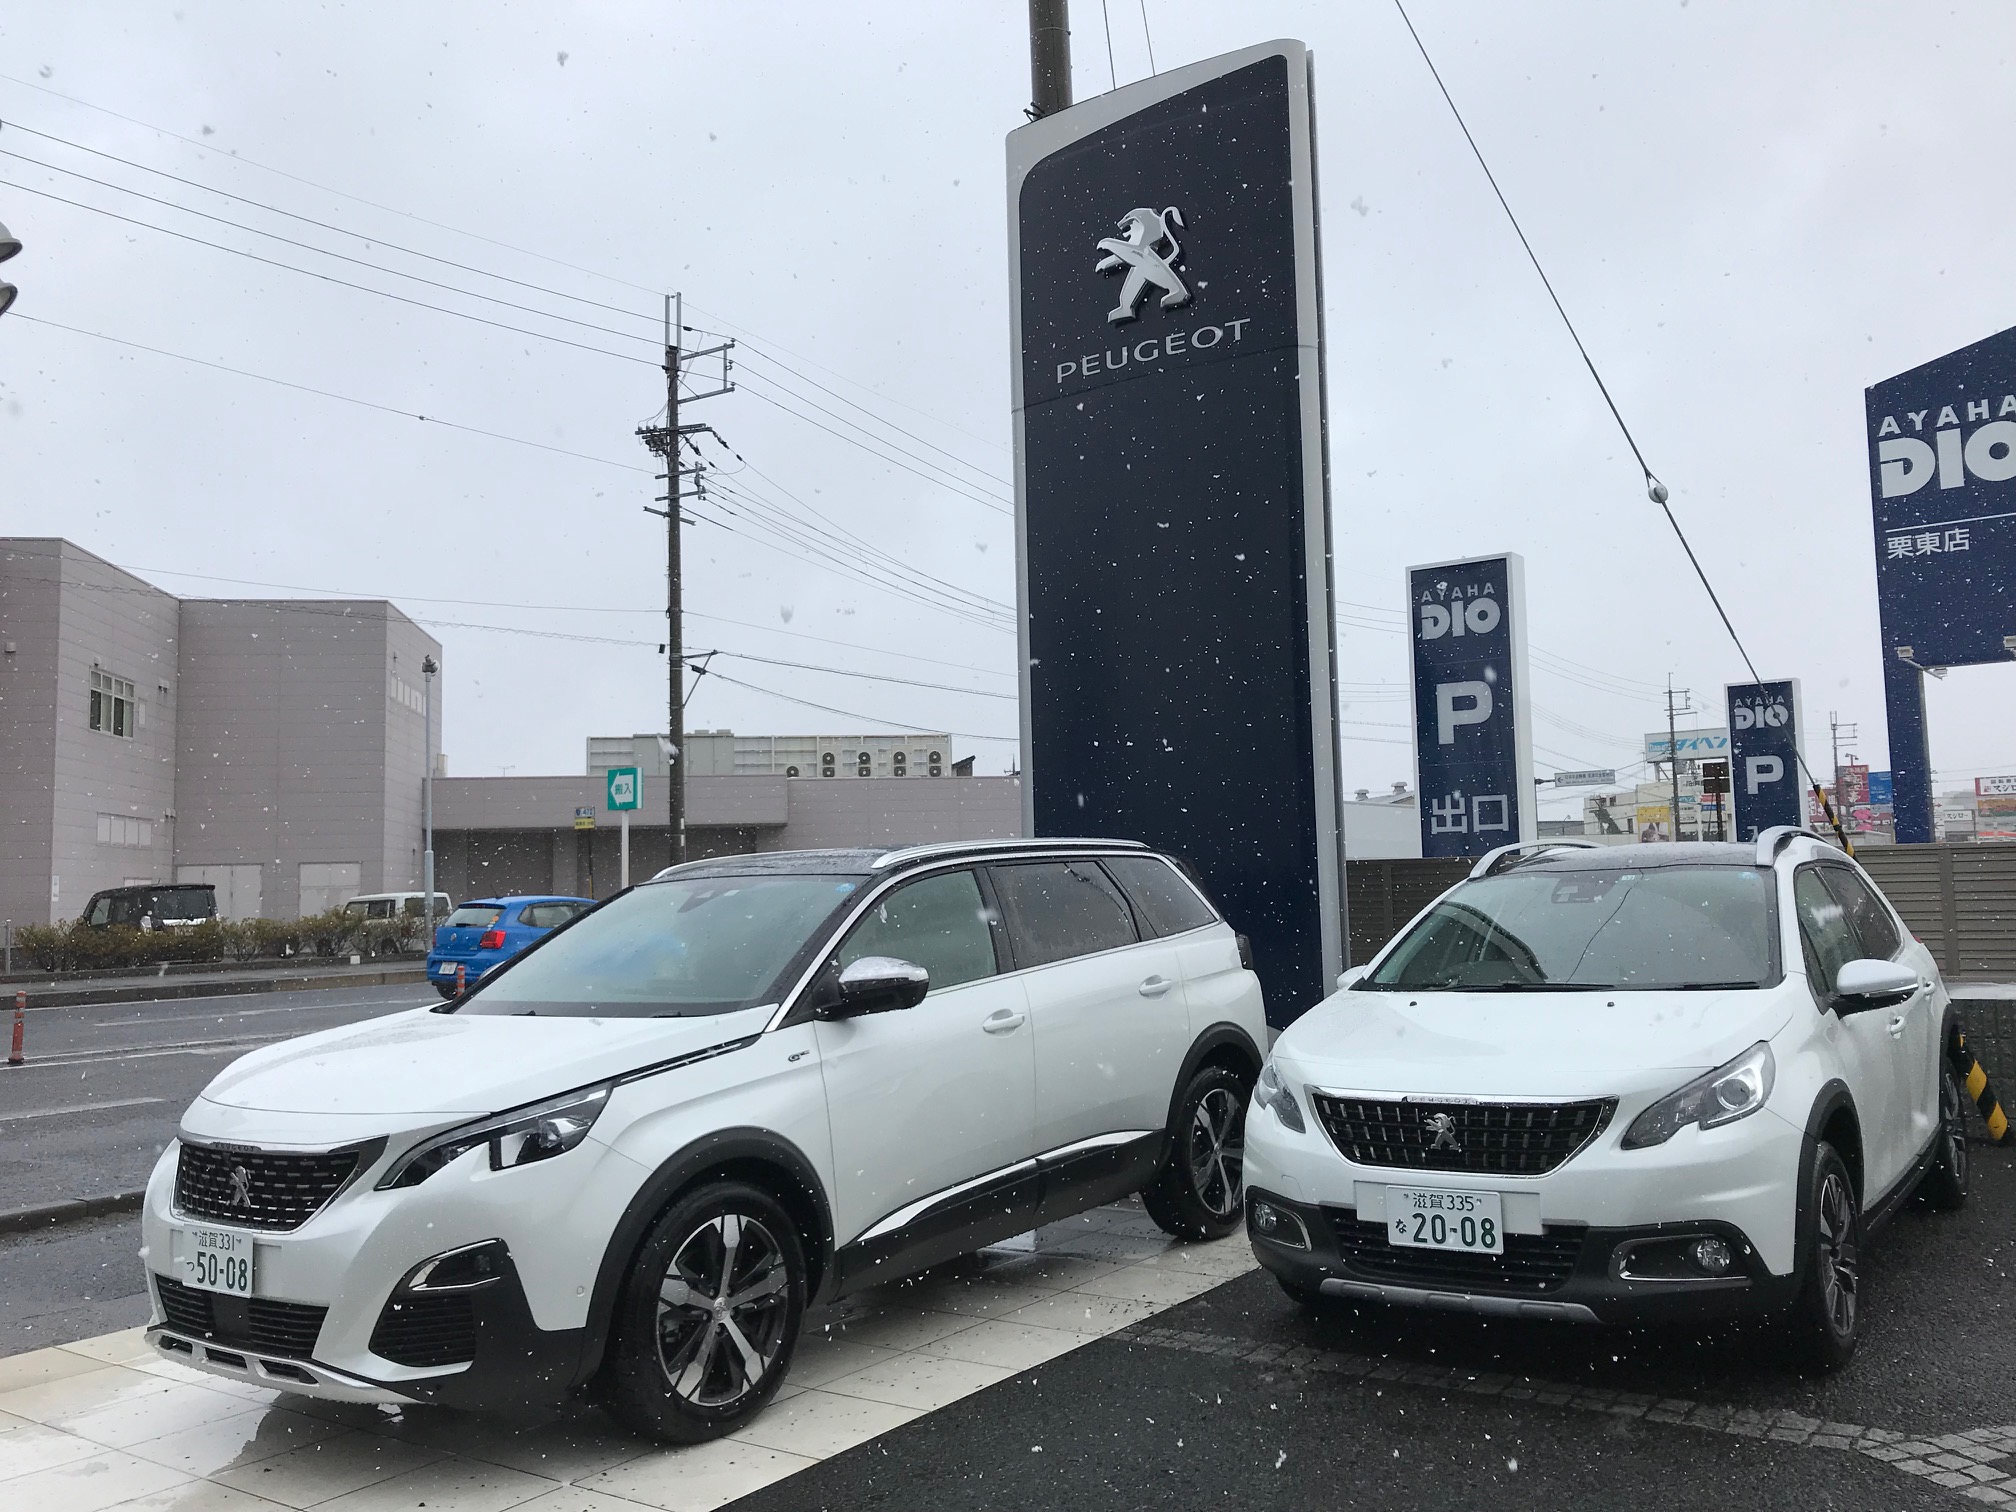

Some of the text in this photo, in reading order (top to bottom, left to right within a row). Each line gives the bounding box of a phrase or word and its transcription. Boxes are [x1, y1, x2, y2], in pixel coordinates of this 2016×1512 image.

[1056, 317, 1251, 384] PEUGEOT
[1878, 394, 2016, 437] AYAHA
[1878, 420, 2016, 499] DIO
[1887, 528, 1970, 559] 栗東店
[1421, 582, 1495, 603] AYAHA
[1420, 597, 1501, 641] DIO
[1436, 680, 1493, 745] P
[1734, 704, 1789, 730] DIO
[1745, 754, 1785, 795] P
[1431, 794, 1510, 835] 出口
[1412, 1212, 1496, 1248] 20-08
[197, 1250, 248, 1291] 50-08
